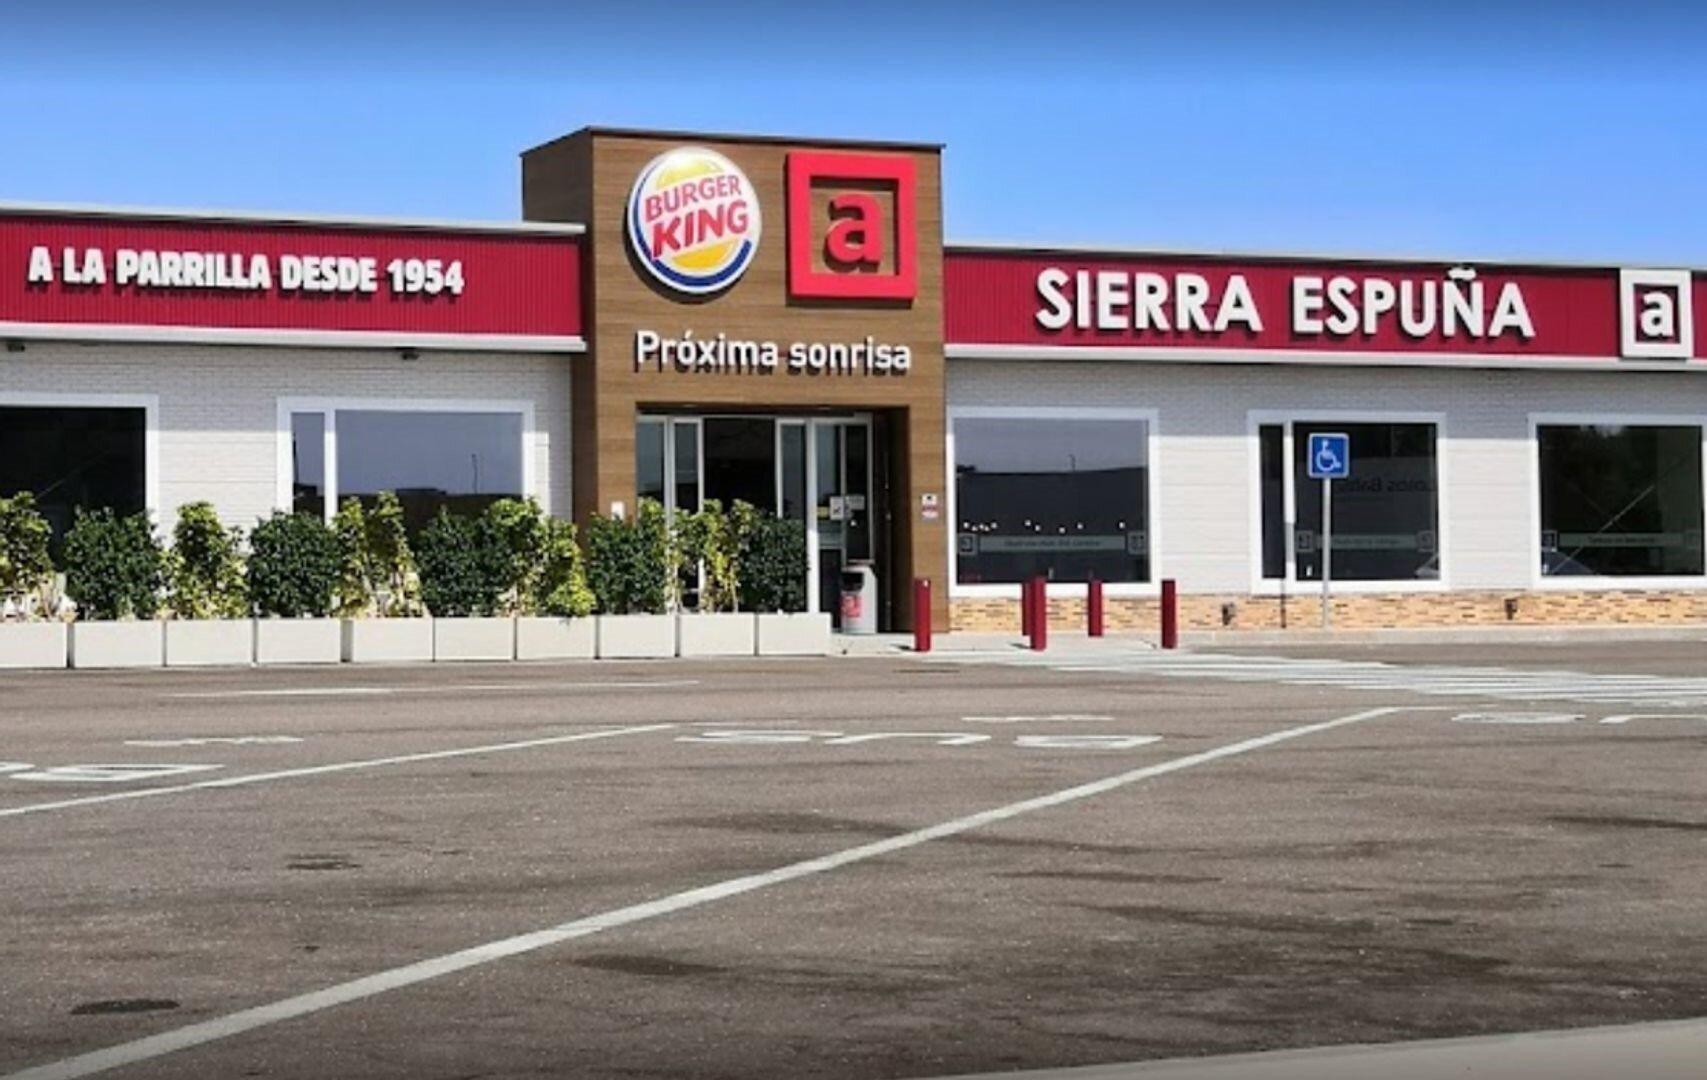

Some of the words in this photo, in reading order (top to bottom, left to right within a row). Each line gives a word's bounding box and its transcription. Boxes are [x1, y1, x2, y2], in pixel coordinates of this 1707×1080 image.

[644, 174, 742, 223] BURGER
[652, 199, 749, 259] KING
[829, 193, 883, 263] a
[28, 246, 54, 283] A
[62, 247, 107, 285] LA
[116, 249, 272, 290] PARRILLA
[280, 255, 378, 293] DESDE
[387, 258, 466, 295] 1954
[1036, 268, 1263, 333] SIERRA
[1292, 266, 1537, 338] ESPUÑA
[1640, 290, 1676, 338] a
[635, 328, 779, 368] Próxima
[788, 335, 912, 370] sonrisa
